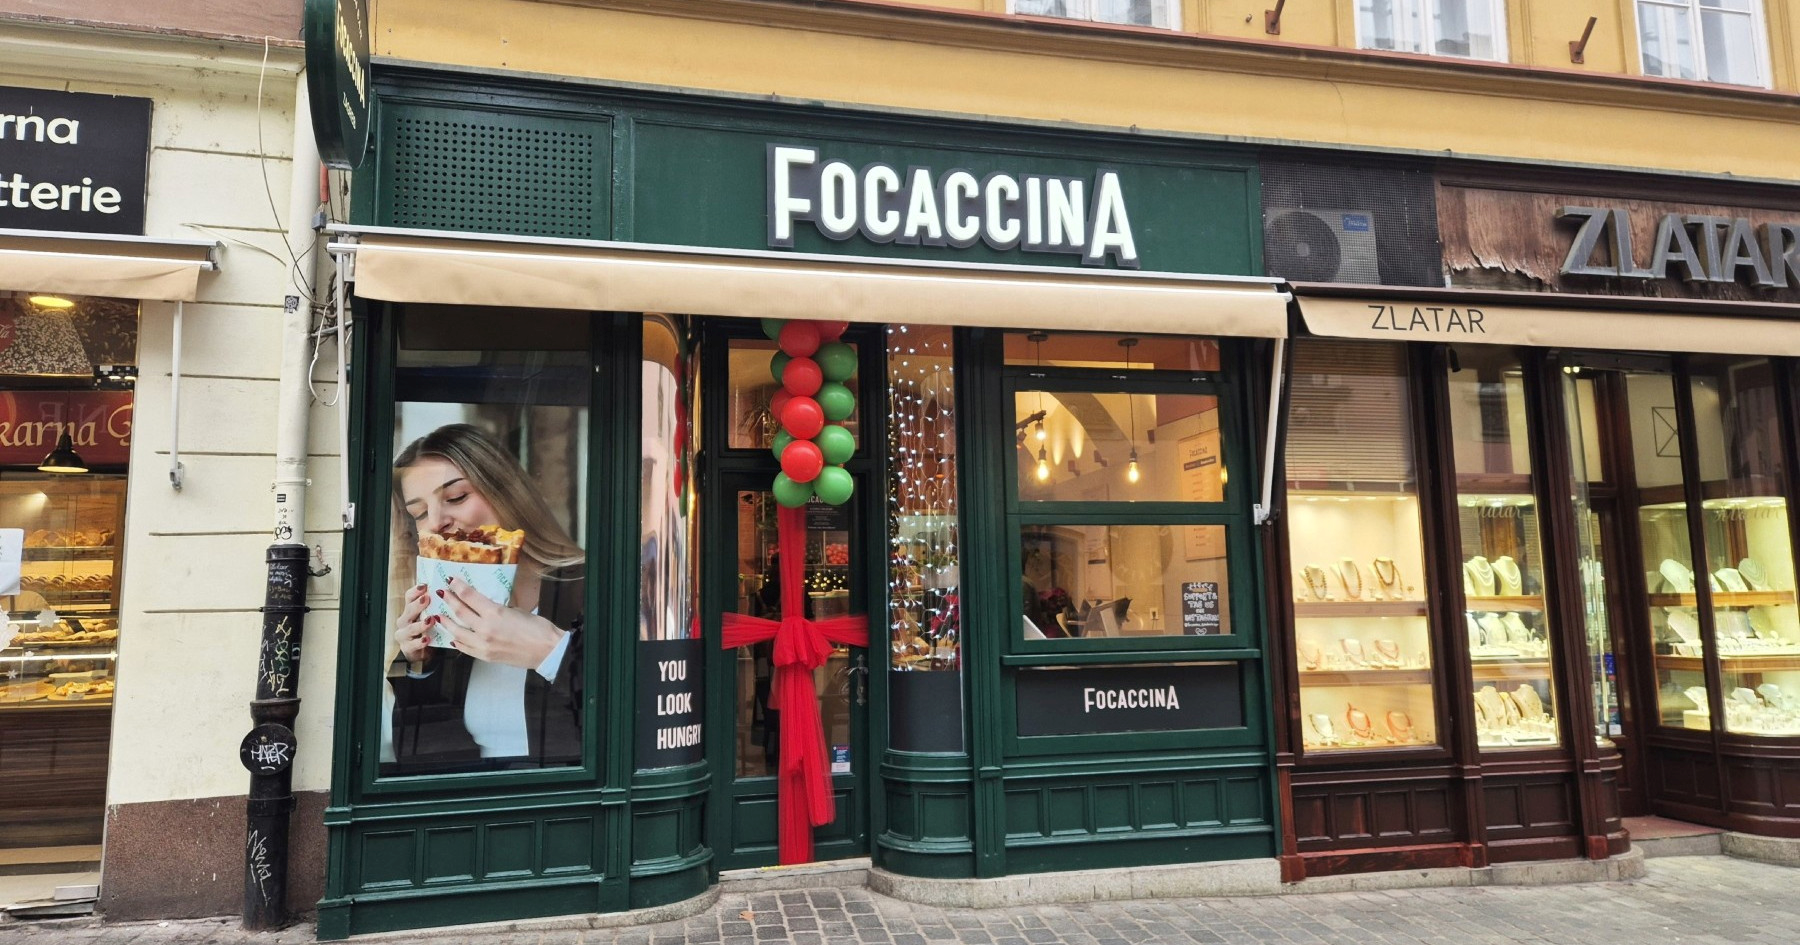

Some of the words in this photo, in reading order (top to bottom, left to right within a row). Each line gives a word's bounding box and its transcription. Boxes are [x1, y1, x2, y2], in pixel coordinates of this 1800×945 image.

[774, 146, 1138, 261] FOCACCINA
[1556, 205, 1800, 289] ZLATAR
[1367, 304, 1486, 334] ZLATAR
[658, 659, 687, 682] YOU
[657, 692, 692, 716] LOOK
[1084, 685, 1180, 714] FOCACCINA
[657, 723, 702, 750] HUNGRY
